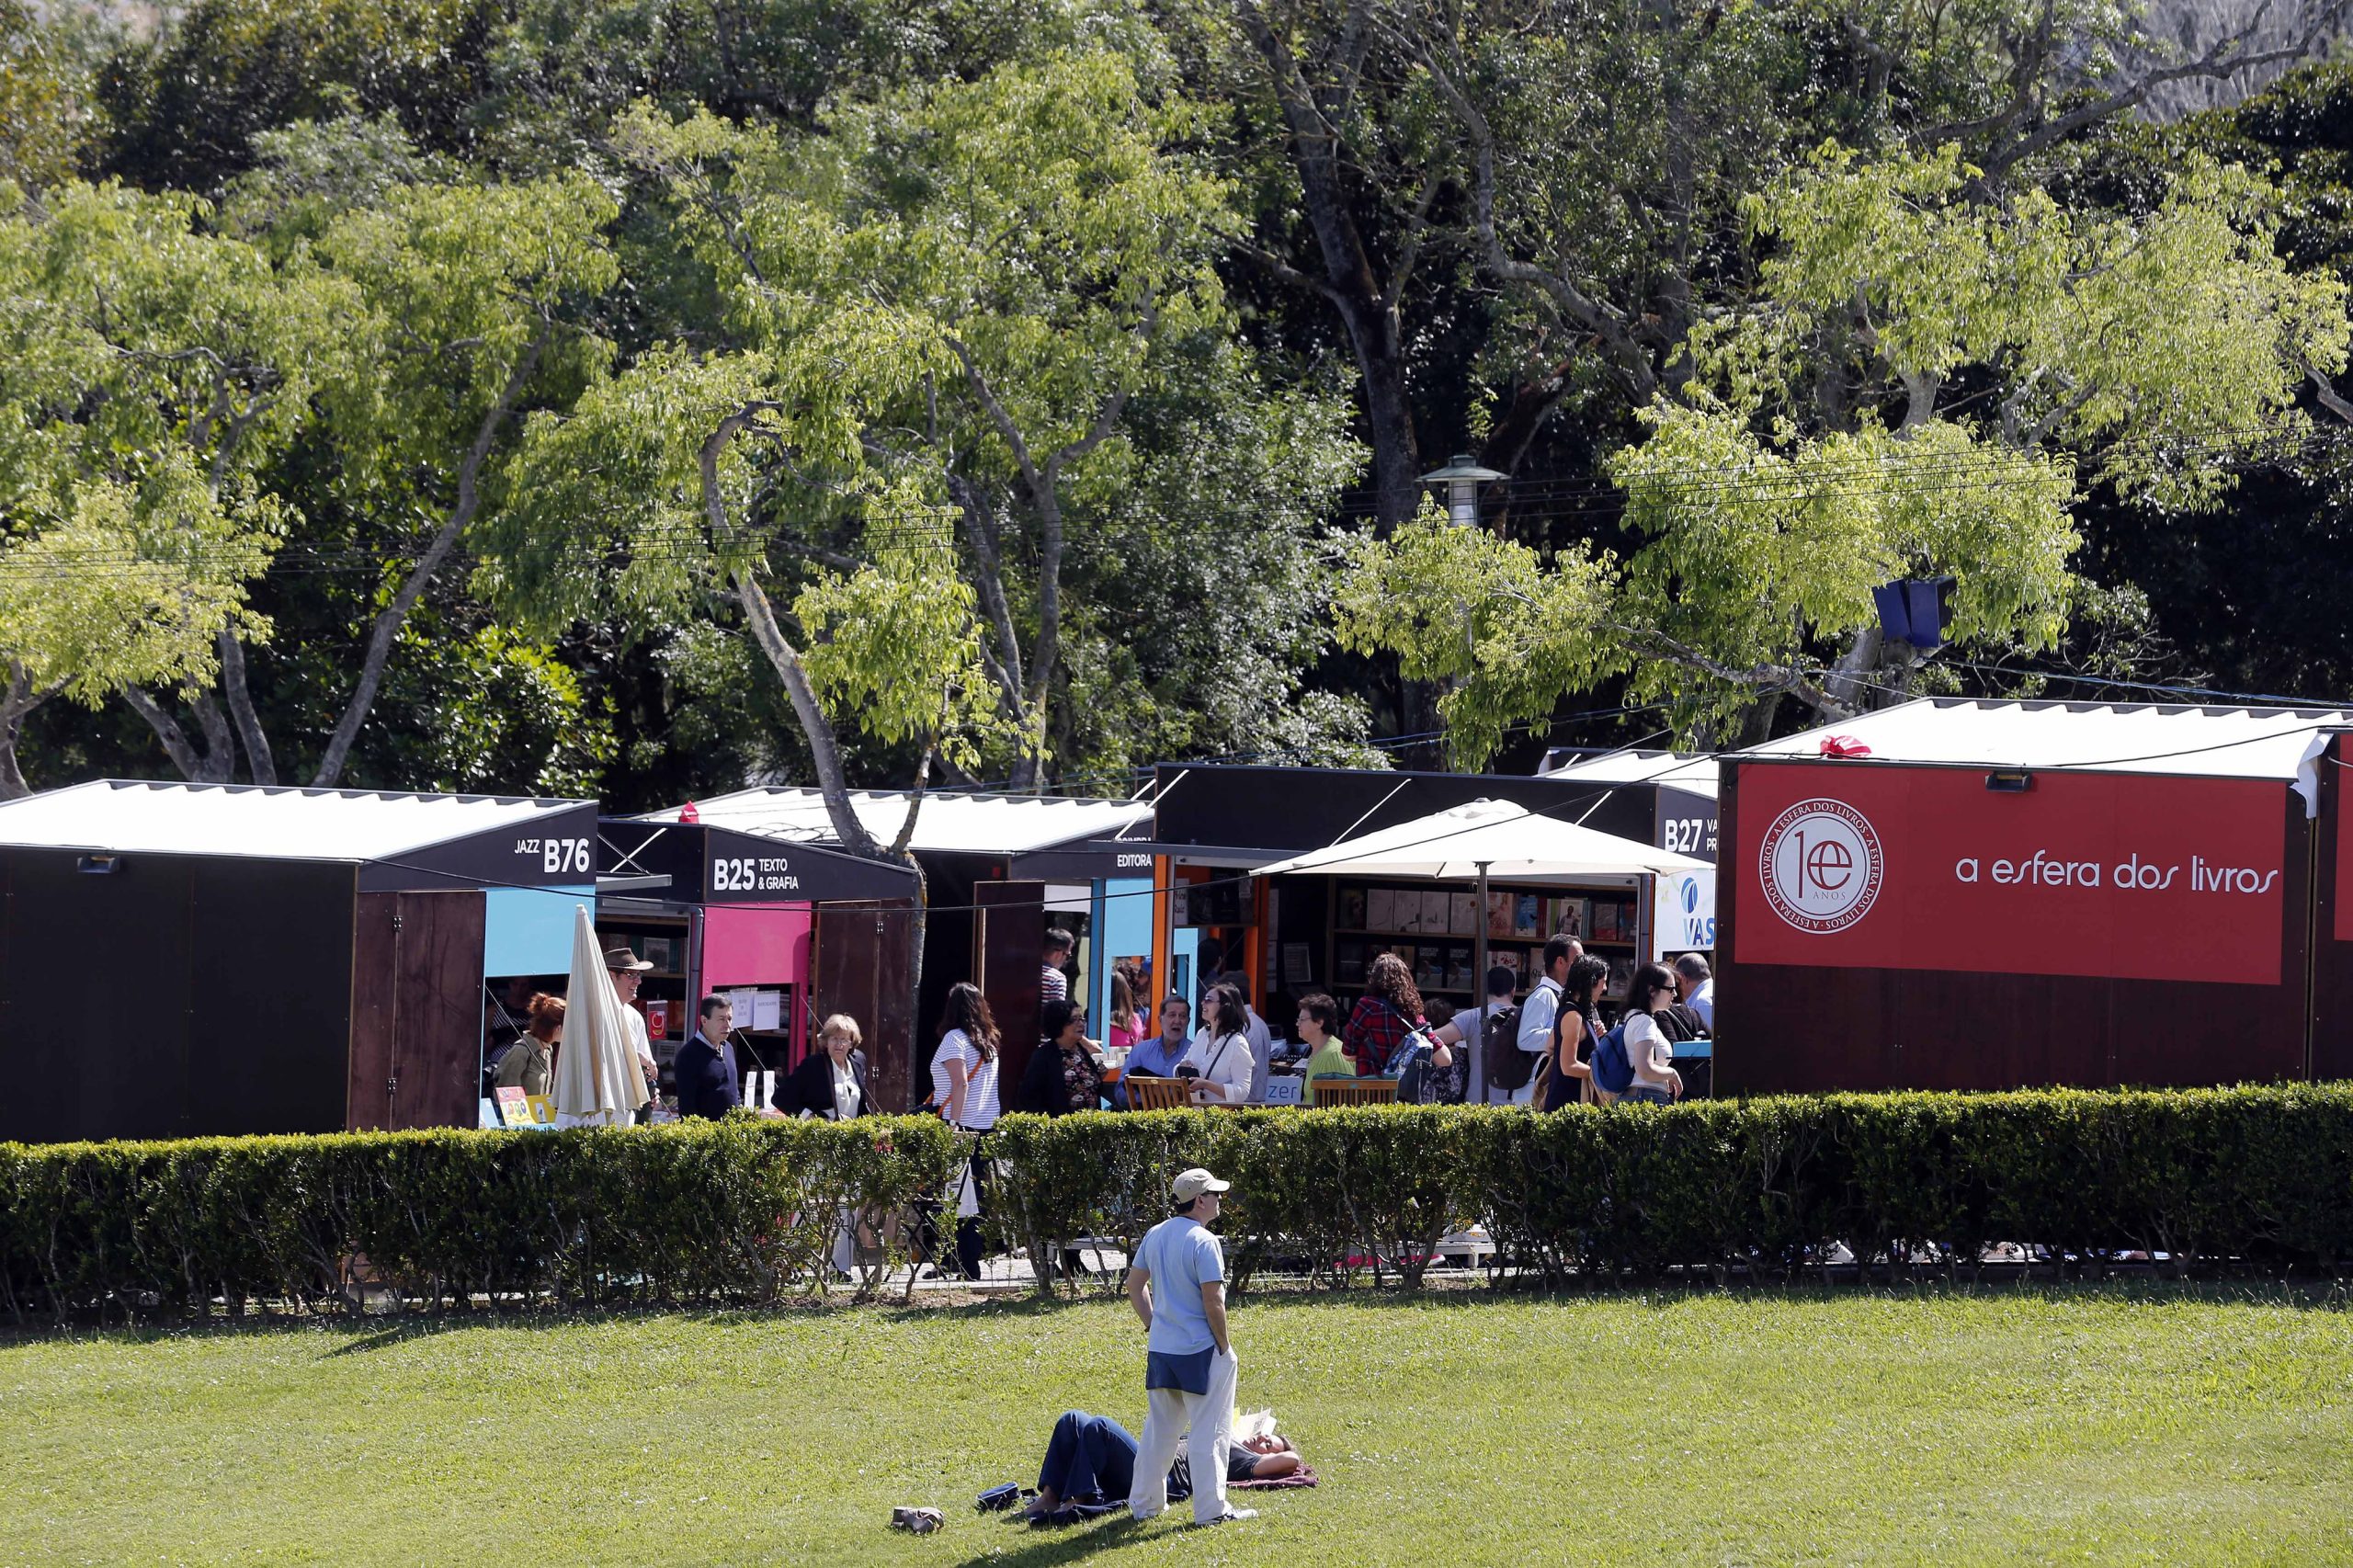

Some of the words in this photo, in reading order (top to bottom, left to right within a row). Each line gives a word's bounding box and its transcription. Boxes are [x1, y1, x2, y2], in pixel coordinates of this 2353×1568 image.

[1774, 828, 1781, 836] A
[1779, 804, 1811, 828] ESFERA
[1813, 802, 1836, 812] DOS
[1836, 805, 1869, 835] LIVROS
[1665, 819, 1703, 853] B27
[1866, 838, 1874, 846] A
[514, 839, 540, 855] JAZZ
[543, 837, 590, 873] B76
[1117, 853, 1153, 868] EDITORA
[1763, 840, 1775, 880] LIVROS
[1870, 846, 1881, 885] ESFERA
[713, 858, 756, 891] B25
[758, 858, 788, 872] TEXTO
[758, 878, 765, 889] &
[766, 876, 799, 890] GRAFIA
[1955, 858, 1978, 882] a
[1991, 849, 2100, 887] esfera
[2113, 852, 2179, 890] dos
[2191, 855, 2279, 893] livros
[1765, 881, 1781, 903] DOS
[1813, 891, 1846, 900] ANOS
[1858, 887, 1875, 910] DOS
[1779, 903, 1811, 928] ESFERA
[1813, 921, 1820, 929] A
[1825, 907, 1860, 929] LIVROS
